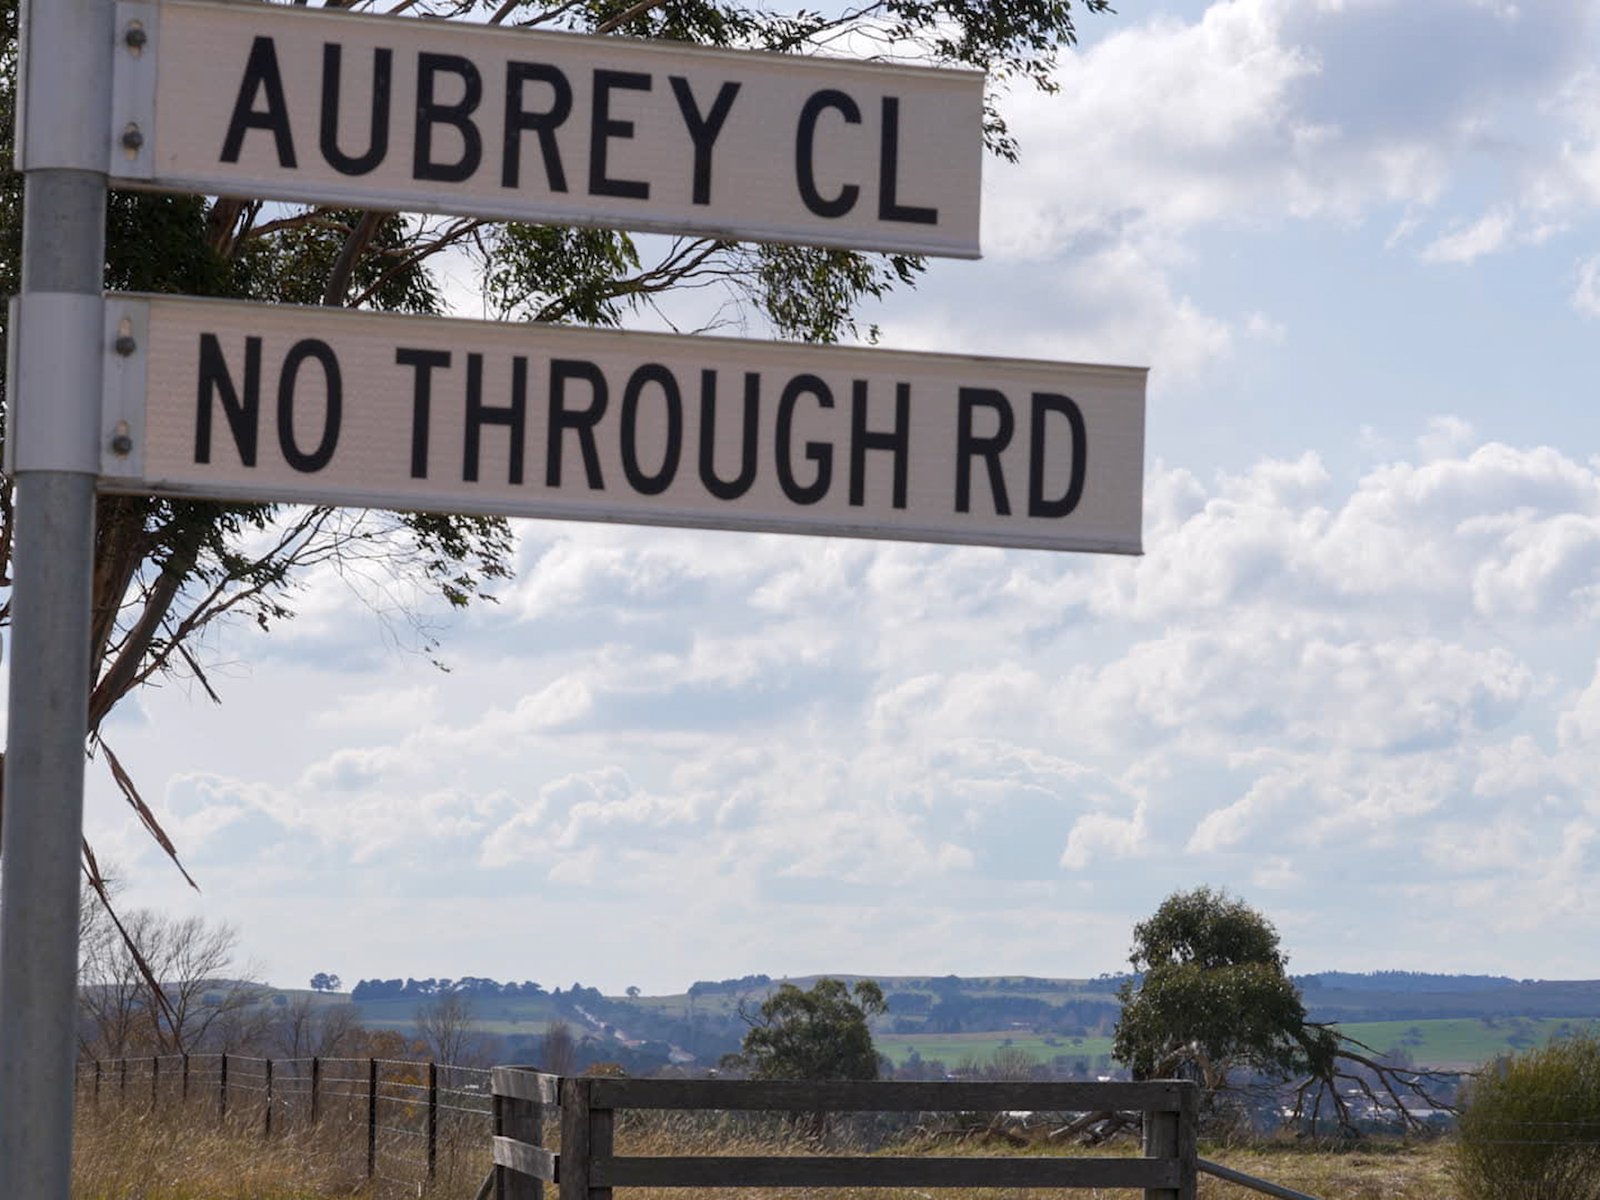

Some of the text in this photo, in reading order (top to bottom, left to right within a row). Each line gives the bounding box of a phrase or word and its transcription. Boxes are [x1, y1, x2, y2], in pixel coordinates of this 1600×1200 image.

[218, 34, 939, 227] AUBREY CL
[193, 331, 1088, 520] NO THROUGH RD
